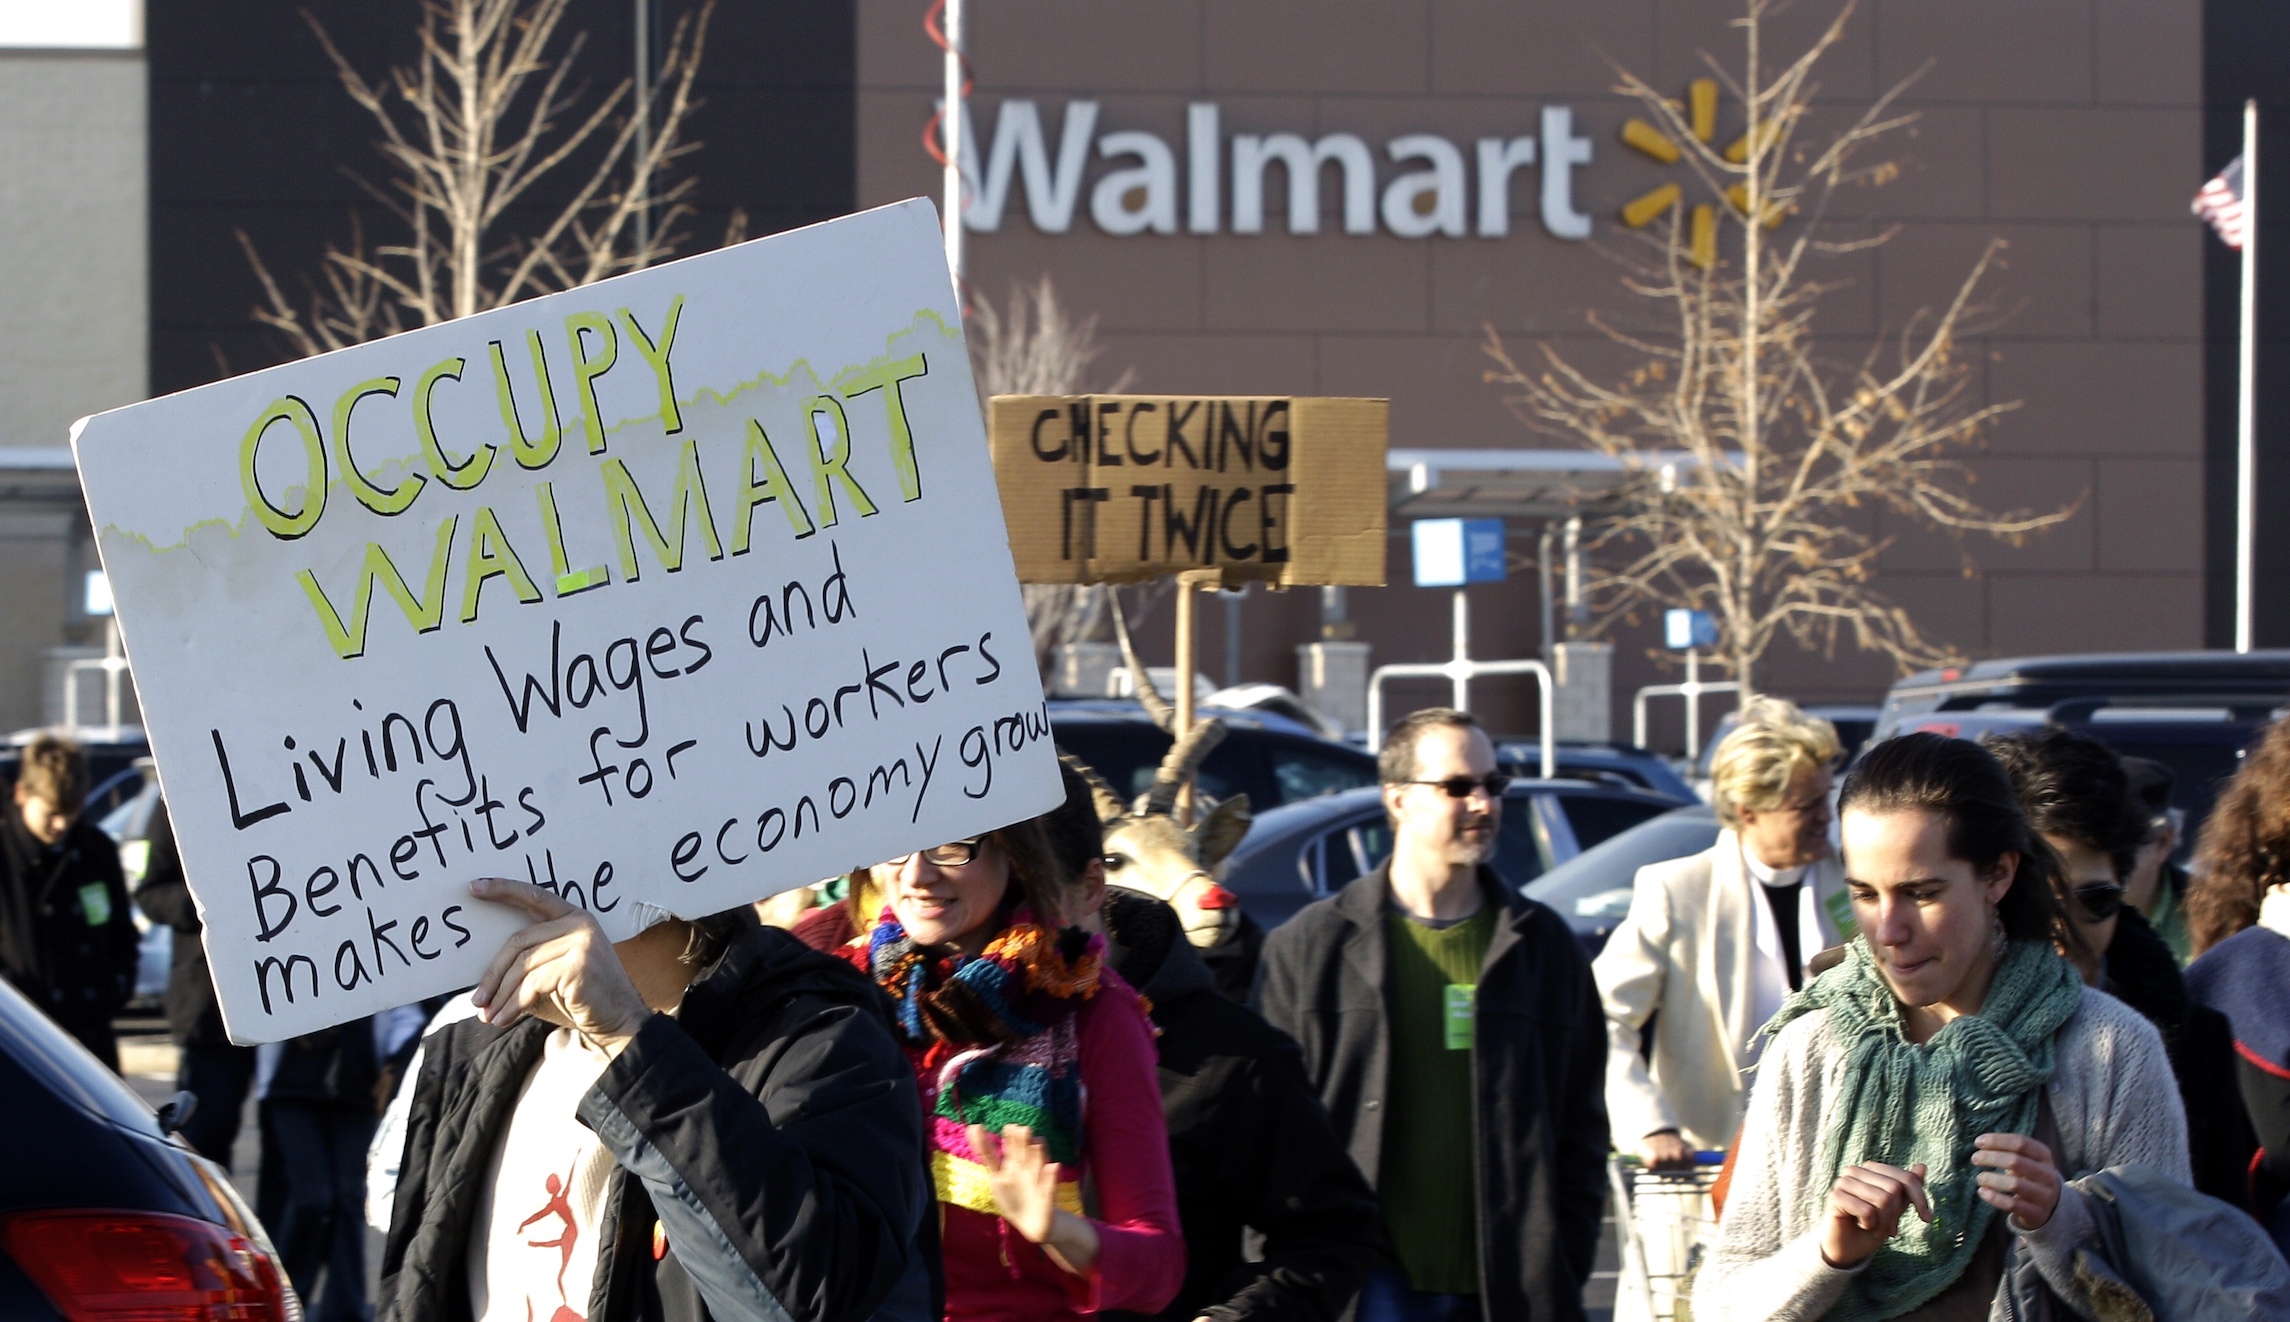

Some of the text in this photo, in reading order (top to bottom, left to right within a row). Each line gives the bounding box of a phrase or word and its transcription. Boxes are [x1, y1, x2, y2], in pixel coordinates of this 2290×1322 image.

[937, 99, 1593, 240] Walmart
[239, 294, 685, 540] OCCUPY
[295, 352, 928, 660] WALMART
[1031, 400, 1290, 473] CHECKING
[1061, 483, 1295, 566] IT TWICE
[211, 539, 857, 830] Living Wages and
[247, 631, 1001, 943] Benefits for workers
[254, 906, 471, 1015] makes
[671, 734, 942, 883] economy
[959, 701, 1050, 799] grow
